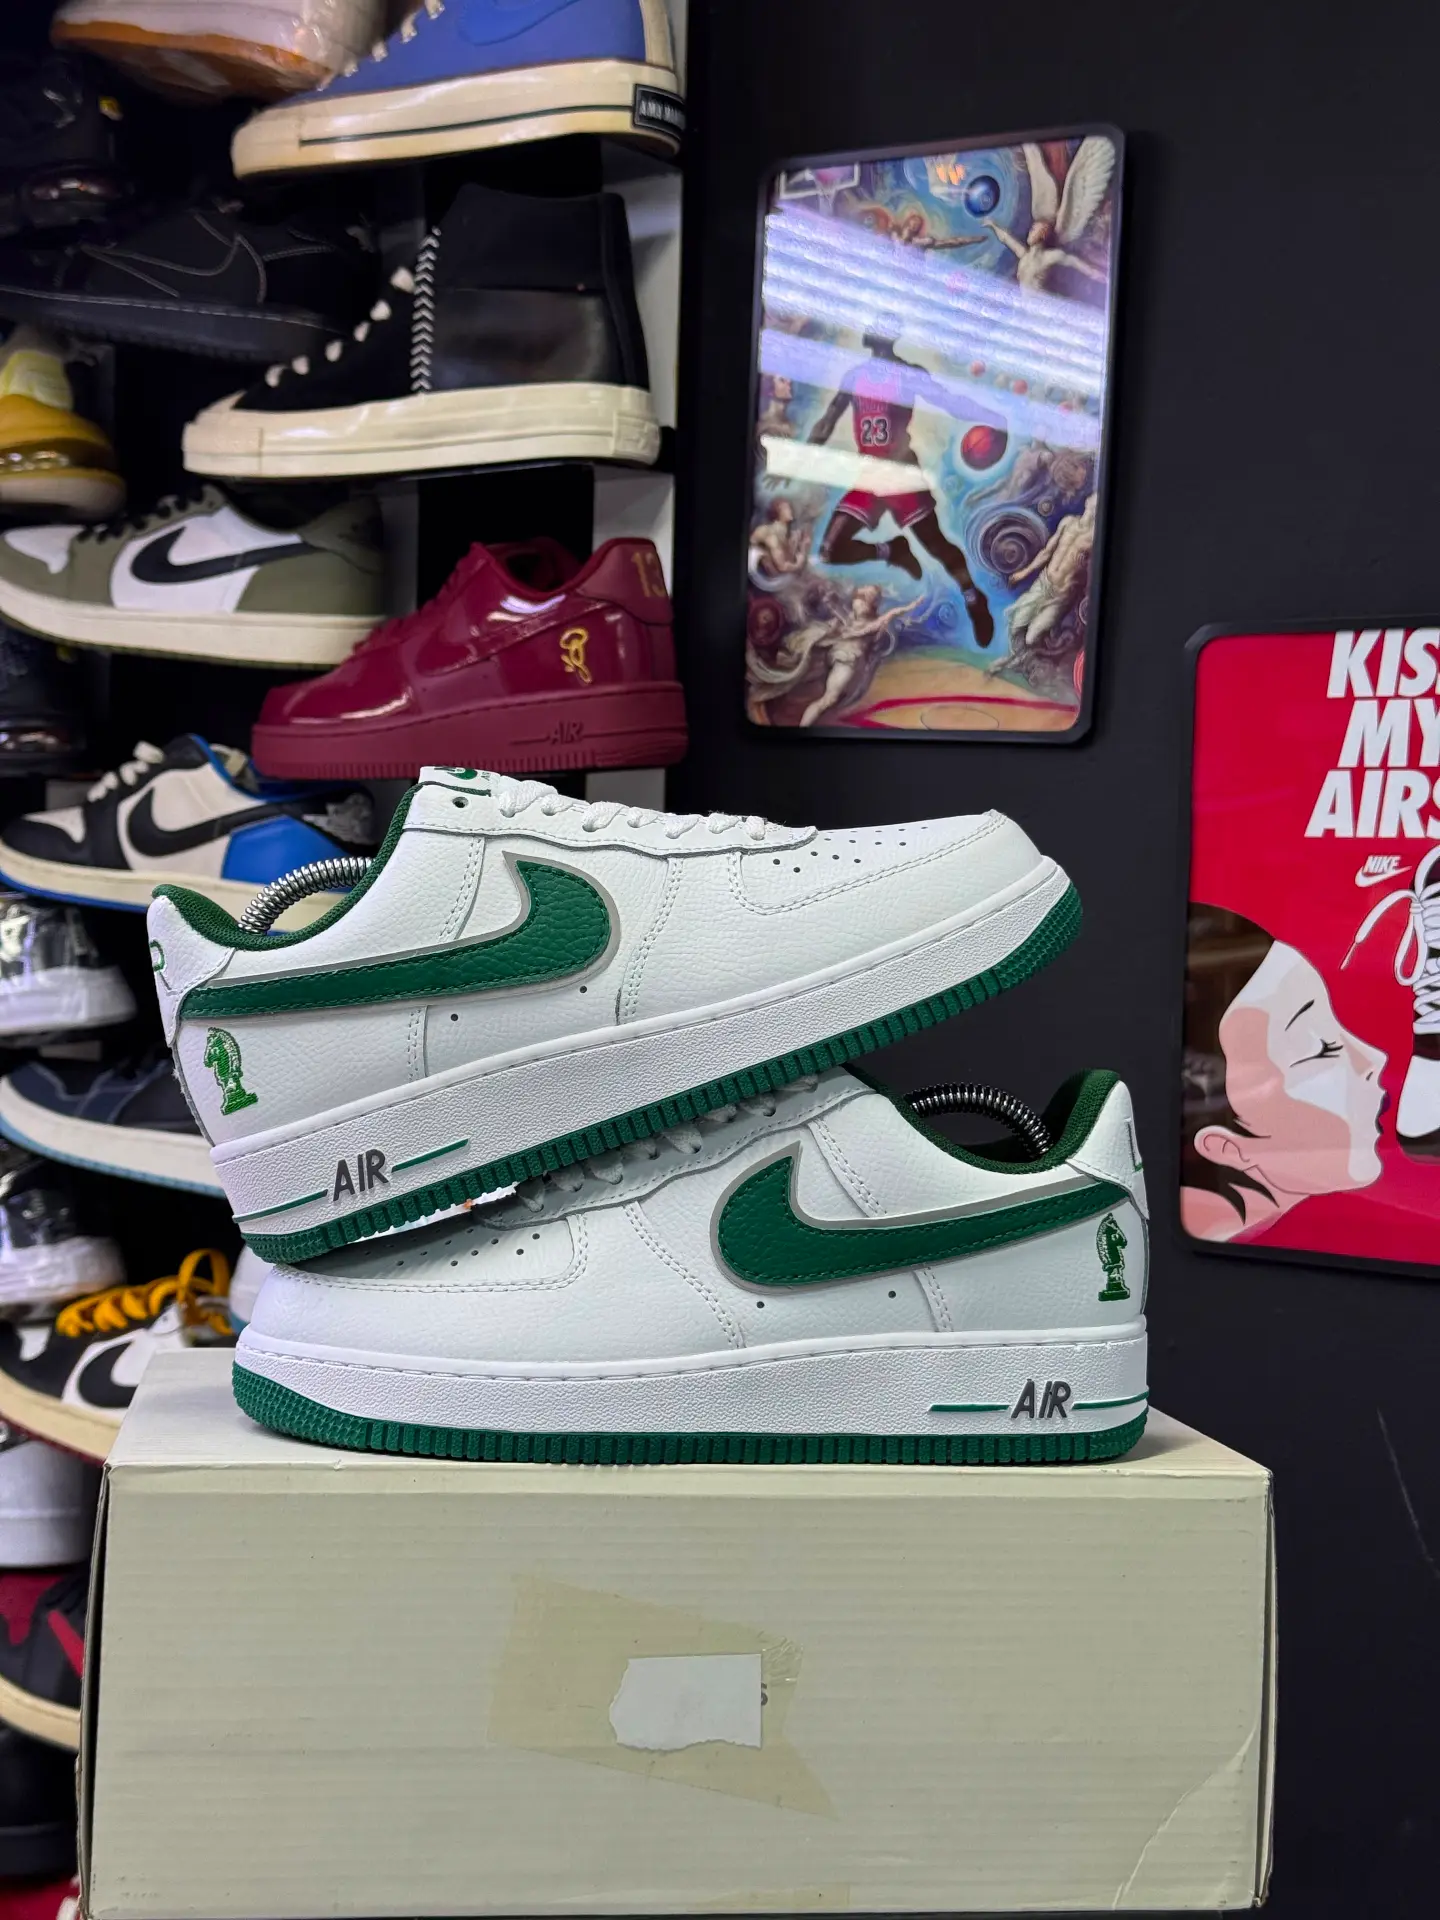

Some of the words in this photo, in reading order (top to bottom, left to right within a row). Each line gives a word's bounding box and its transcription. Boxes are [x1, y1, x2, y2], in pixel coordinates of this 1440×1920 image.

[861, 416, 888, 447] 23
[1327, 628, 1440, 699] KIS
[552, 720, 584, 745] AIR
[1362, 855, 1402, 874] NIKE
[333, 1149, 389, 1201] AIR
[1010, 1379, 1071, 1419] AIR
